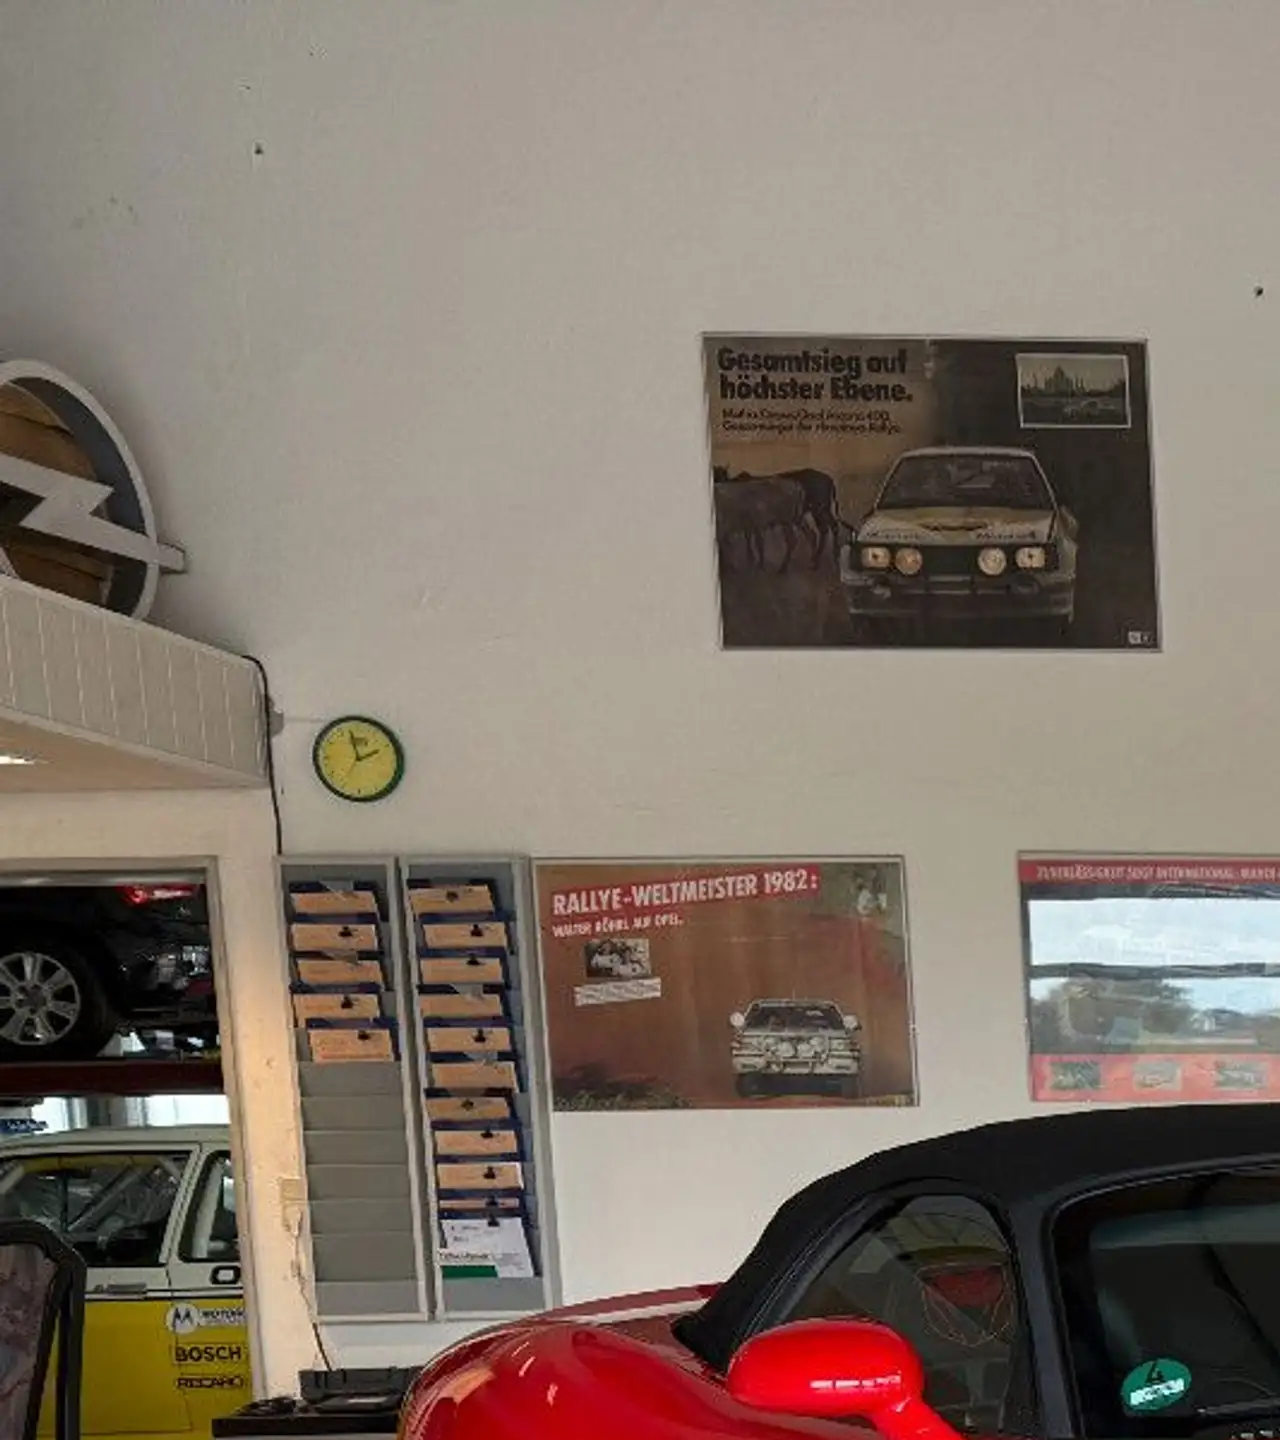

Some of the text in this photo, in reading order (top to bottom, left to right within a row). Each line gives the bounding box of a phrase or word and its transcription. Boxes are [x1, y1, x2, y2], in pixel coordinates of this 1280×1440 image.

[718, 348, 907, 378] Gesamtsieg auf
[720, 373, 913, 402] höchster Ebene.
[553, 867, 818, 916] RALLYE-WELTMEISTER 1982:
[175, 1346, 242, 1361] BOSCH
